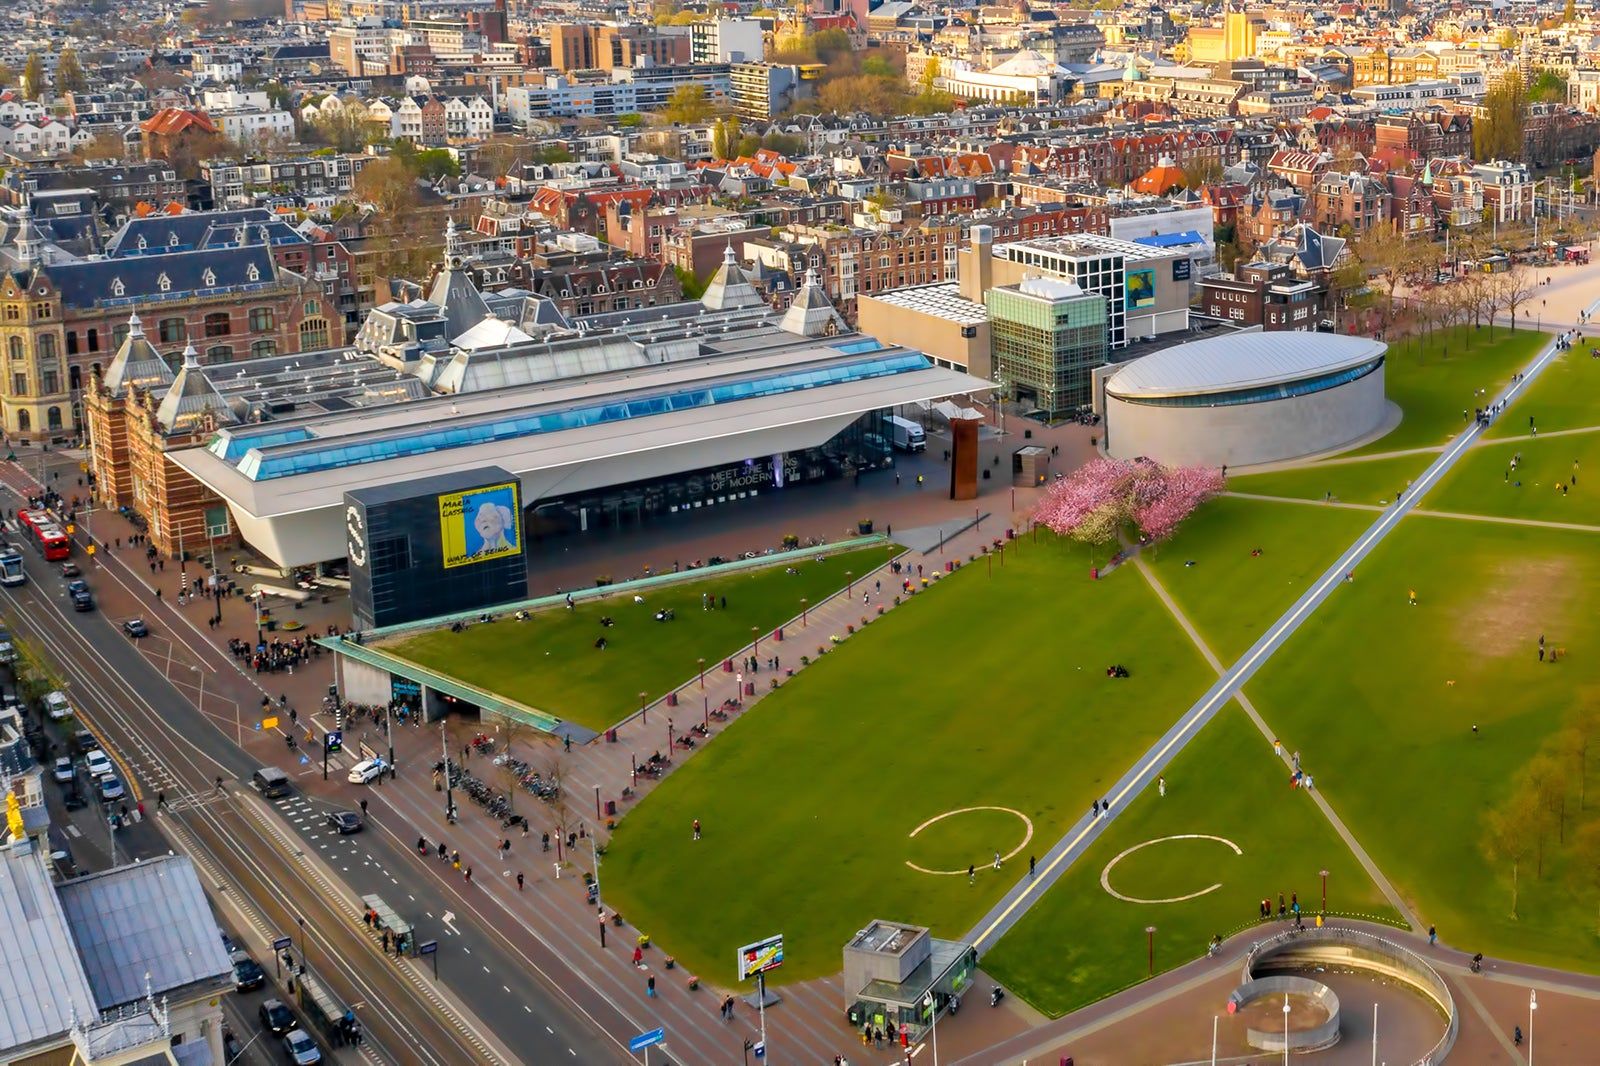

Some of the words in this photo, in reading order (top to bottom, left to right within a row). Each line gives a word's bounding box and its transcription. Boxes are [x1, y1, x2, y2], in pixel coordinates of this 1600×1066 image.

[711, 468, 738, 481] MEET
[767, 457, 798, 471] ICNS
[711, 481, 725, 491] OF
[729, 472, 773, 487] MODERN
[442, 499, 471, 509] MARIA
[484, 546, 509, 556] BEING
[328, 735, 336, 745] P
